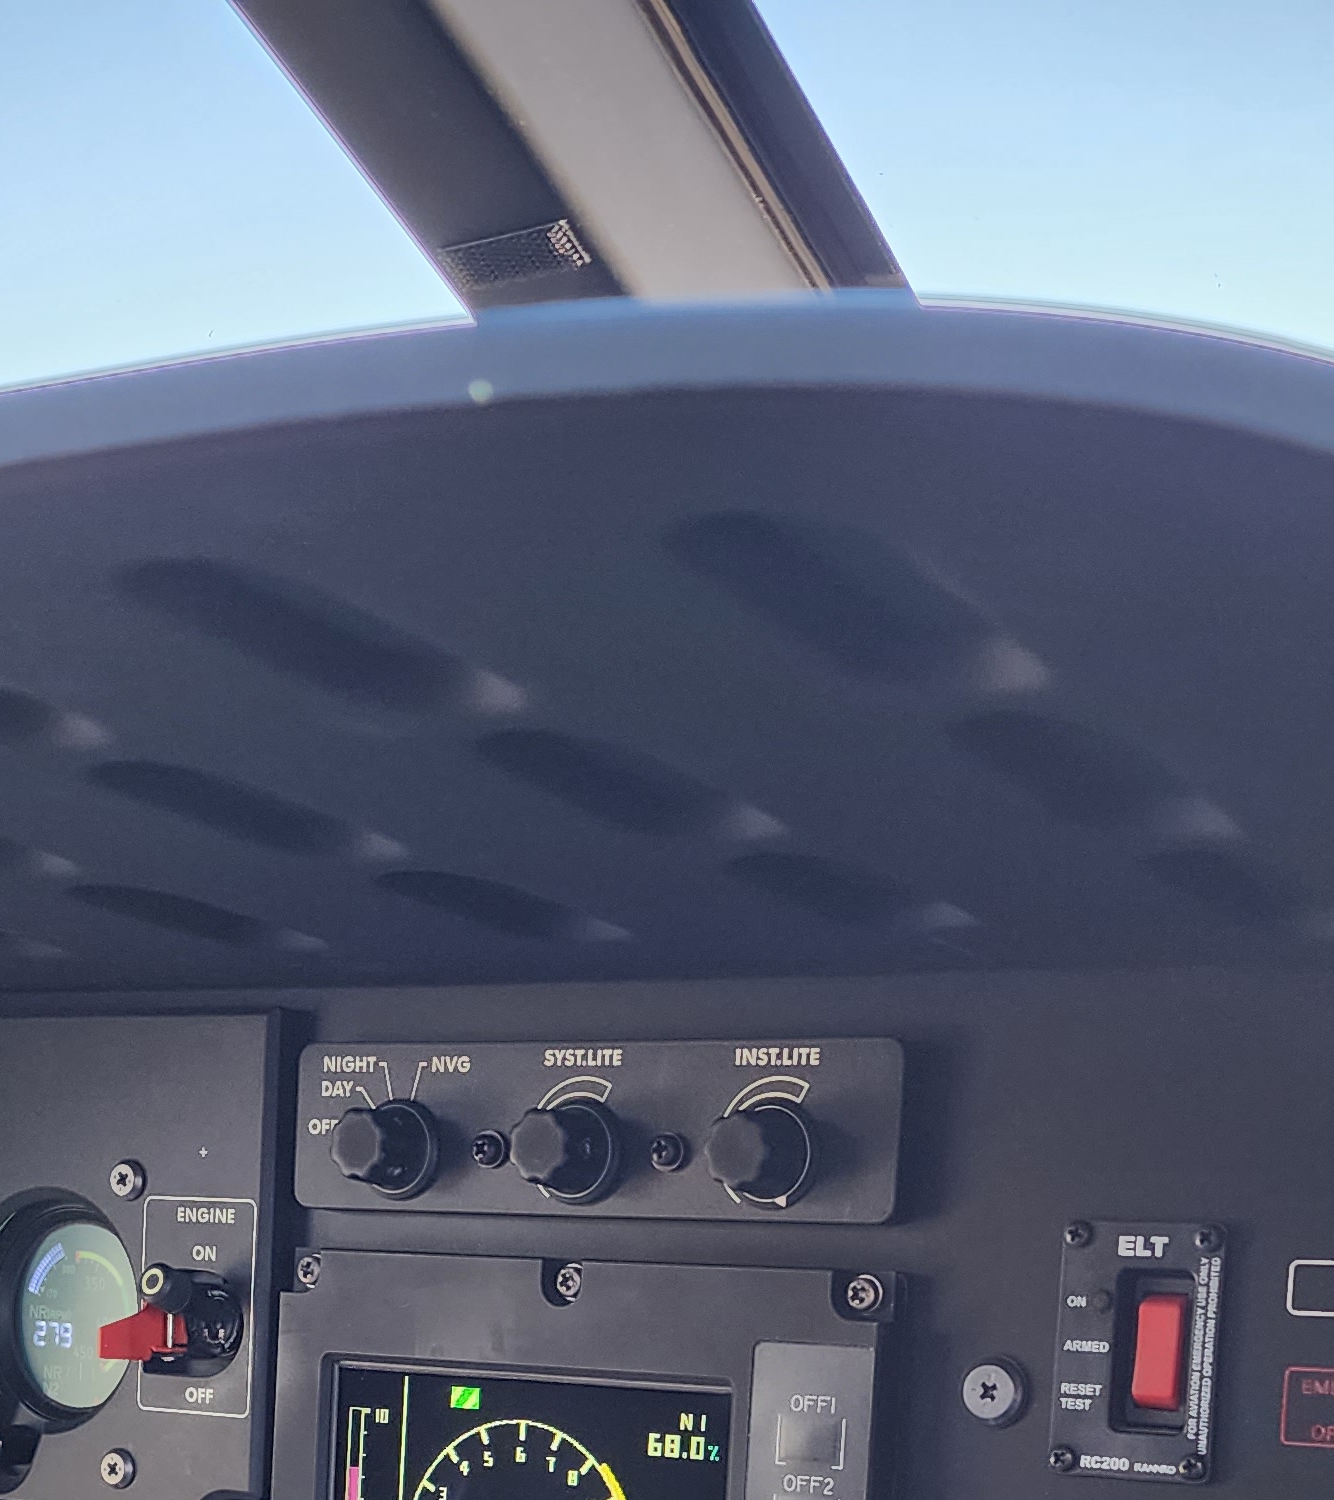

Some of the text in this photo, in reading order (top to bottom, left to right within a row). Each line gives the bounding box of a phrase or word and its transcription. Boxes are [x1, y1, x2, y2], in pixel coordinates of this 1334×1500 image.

[323, 1056, 377, 1073] NIGHT
[431, 1056, 471, 1073] NVG
[544, 1049, 623, 1067] SYST.LITE
[735, 1047, 820, 1067] INST.LITE
[321, 1081, 354, 1097] DAY
[177, 1207, 235, 1224] ENGINE
[192, 1246, 216, 1261] ON
[1118, 1236, 1169, 1257] ELT
[1067, 1296, 1086, 1307] ON
[33, 1320, 73, 1348] 279
[1063, 1340, 1110, 1353] ARMED
[185, 1387, 214, 1404] OFF
[1061, 1383, 1102, 1396] RESET
[1060, 1399, 1092, 1411] TEST
[1080, 1455, 1129, 1471] RC200
[783, 1474, 835, 1496] OFF2
